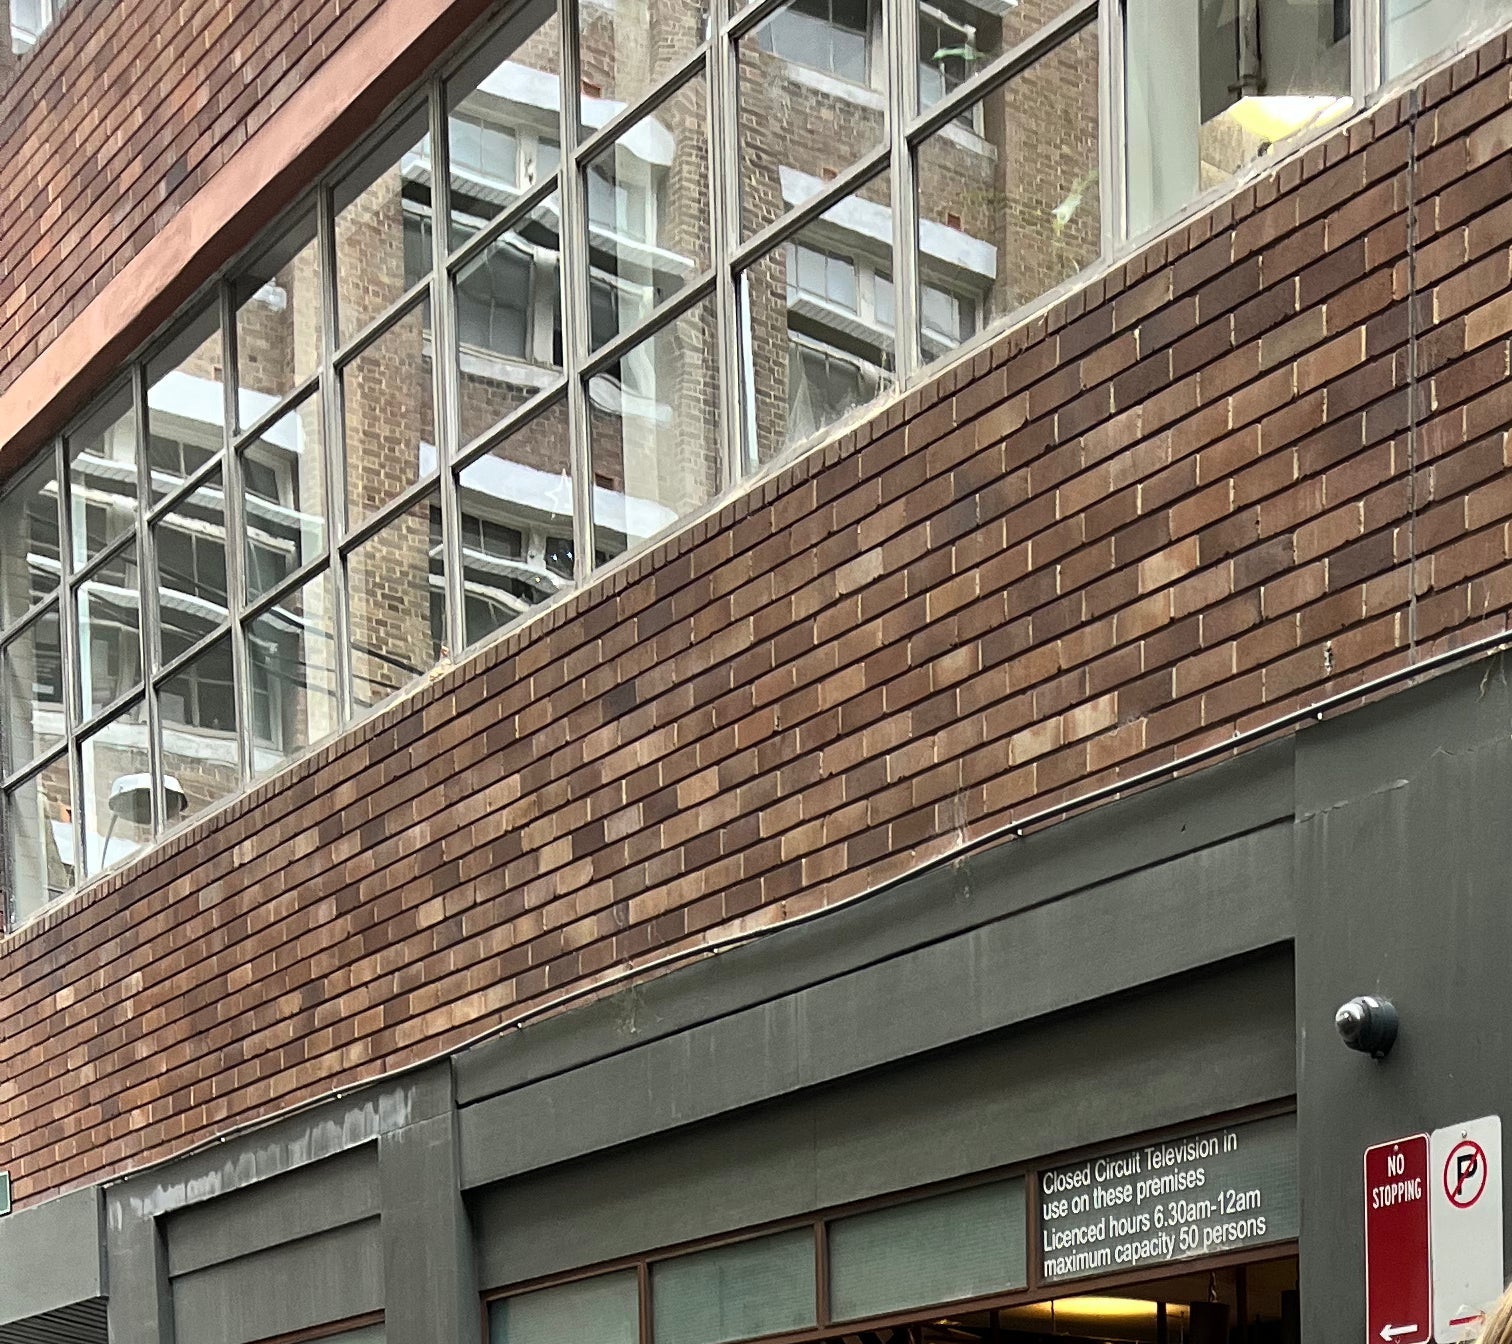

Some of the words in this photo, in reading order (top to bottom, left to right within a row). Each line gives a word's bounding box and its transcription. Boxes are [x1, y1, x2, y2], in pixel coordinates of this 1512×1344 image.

[1043, 1163, 1091, 1195] Closed
[1094, 1151, 1141, 1183] Circuit
[1144, 1133, 1219, 1171] Television
[1223, 1130, 1238, 1153] in
[1387, 1153, 1405, 1177] NO
[1043, 1199, 1069, 1221] use
[1071, 1195, 1090, 1215] on
[1093, 1185, 1133, 1210] these
[1136, 1167, 1206, 1204] premises
[1043, 1218, 1106, 1252] Licenced
[1109, 1212, 1151, 1238] hours
[1153, 1188, 1261, 1229] 6.30am-12am
[1372, 1178, 1422, 1210] STOPPING
[1043, 1247, 1111, 1278] maximum
[1114, 1231, 1176, 1266] capacity
[1178, 1225, 1199, 1250] 50
[1203, 1215, 1267, 1250] persons
